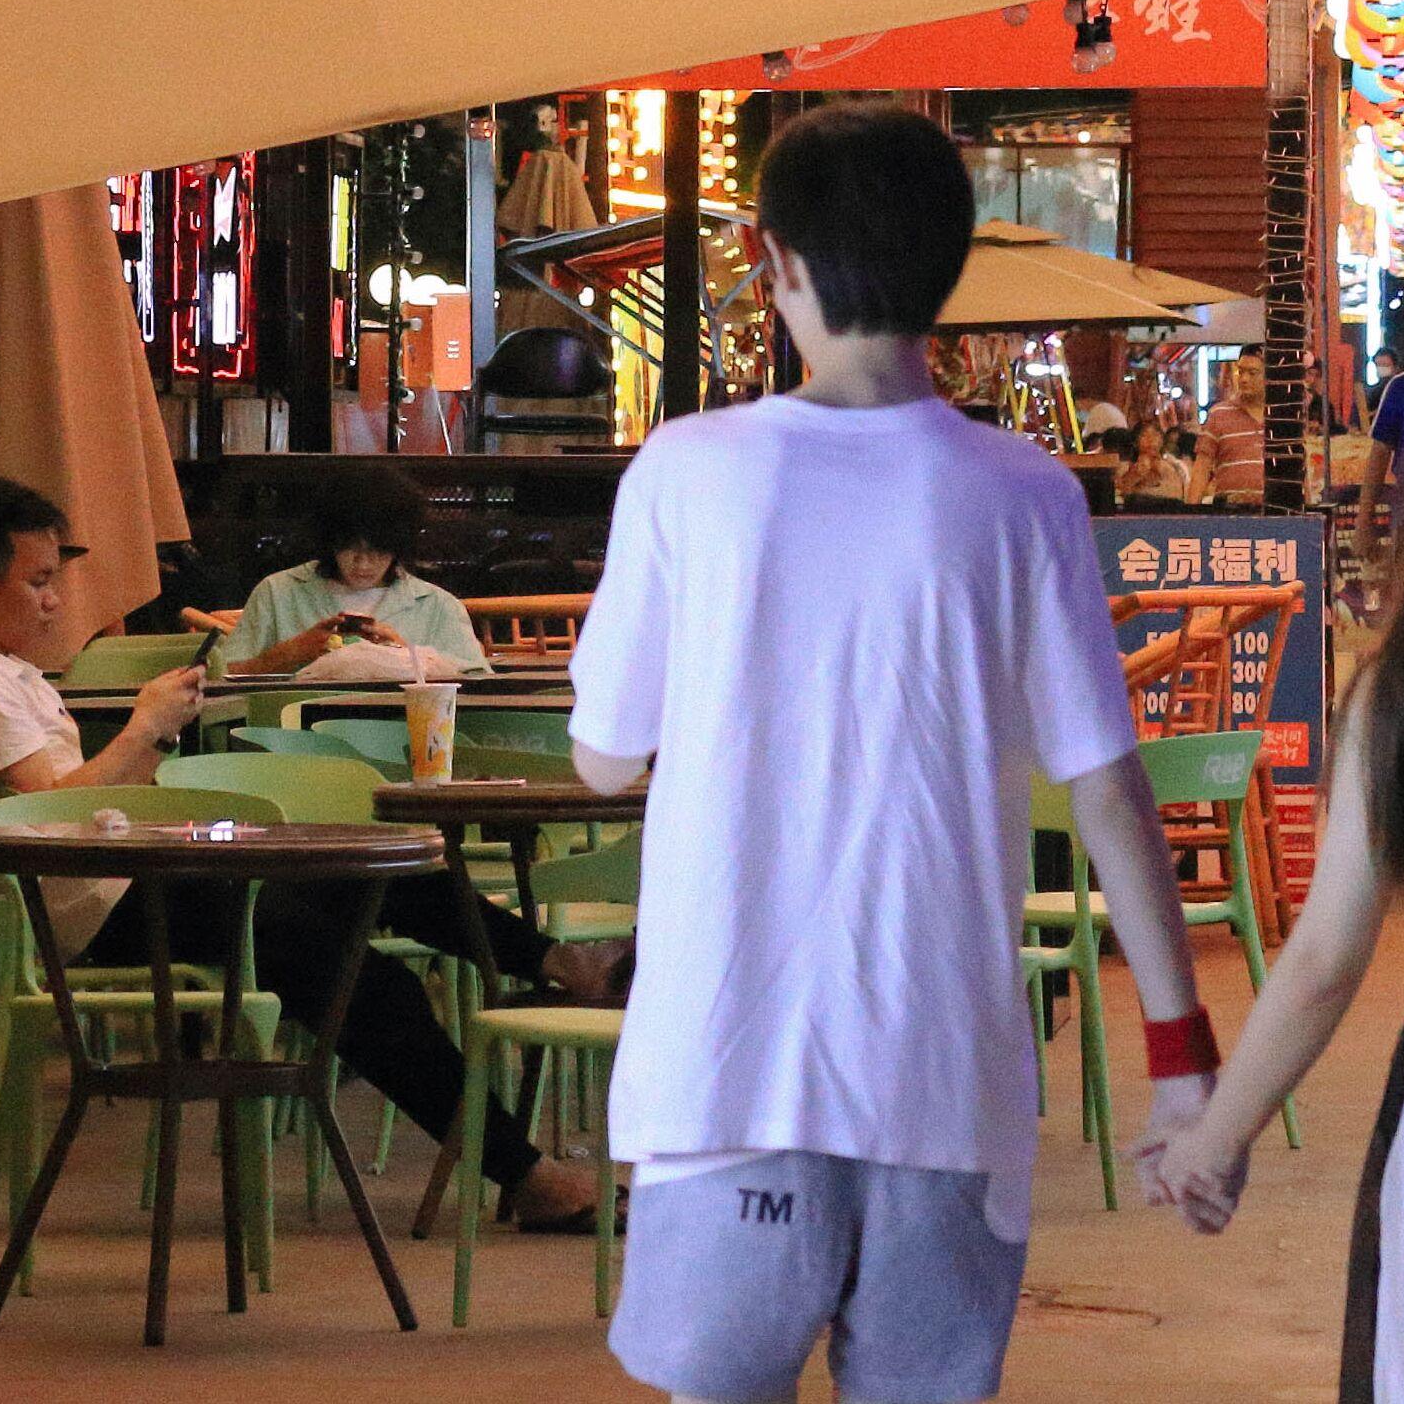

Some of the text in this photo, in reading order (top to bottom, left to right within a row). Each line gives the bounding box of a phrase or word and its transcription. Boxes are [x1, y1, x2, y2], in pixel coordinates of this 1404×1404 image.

[1117, 538, 1297, 582] 会员福利
[1232, 631, 1269, 655] 100
[1232, 661, 1268, 684] 300
[1231, 692, 1261, 714] 80
[737, 1188, 794, 1224] TM
